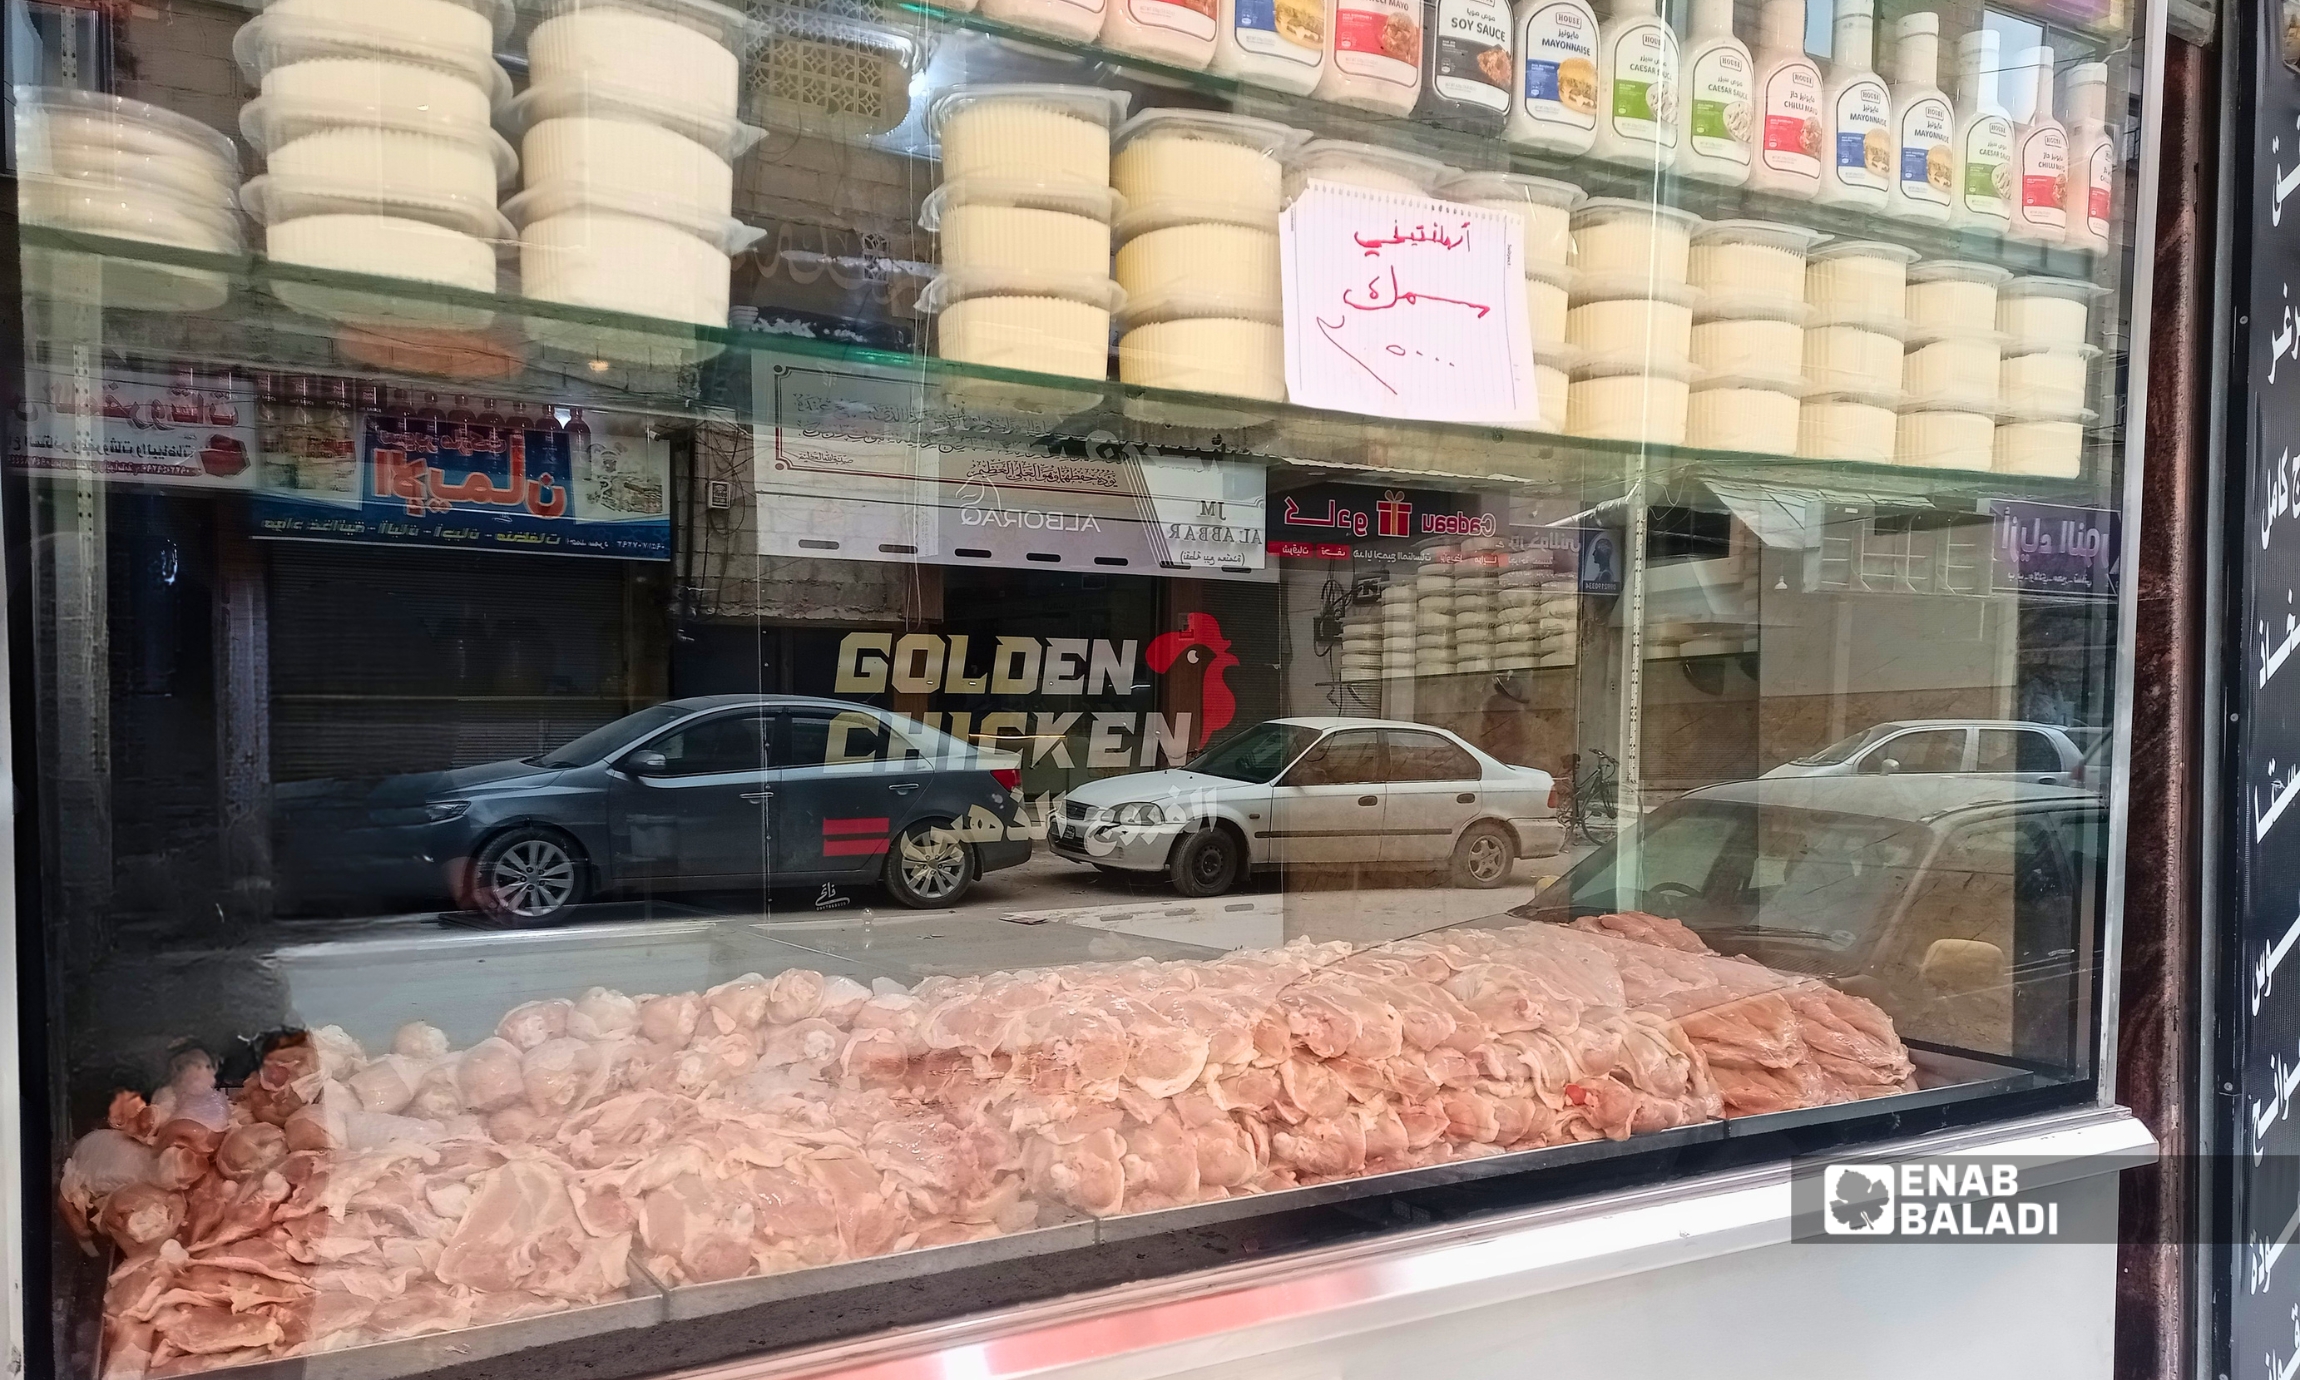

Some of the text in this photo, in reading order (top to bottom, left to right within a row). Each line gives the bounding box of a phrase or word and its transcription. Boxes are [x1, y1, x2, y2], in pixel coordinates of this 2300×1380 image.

[1558, 14, 1580, 26] HOUSE
[1451, 17, 1506, 42] SOY SAUCE
[1541, 38, 1591, 56] MAYONNAISE
[1629, 63, 1656, 75] CAESAR
[1721, 57, 1741, 69] HOUSE
[1707, 83, 1748, 100] CAESAR SAUCE
[1783, 100, 1804, 111] CHILLI
[1849, 113, 1887, 127] MAYONNAISE
[1914, 128, 1950, 144] MAYONNAISE
[1979, 148, 1999, 158] CAESAR
[834, 632, 1138, 696] GOLDEN
[822, 711, 1193, 775] CHICKEN
